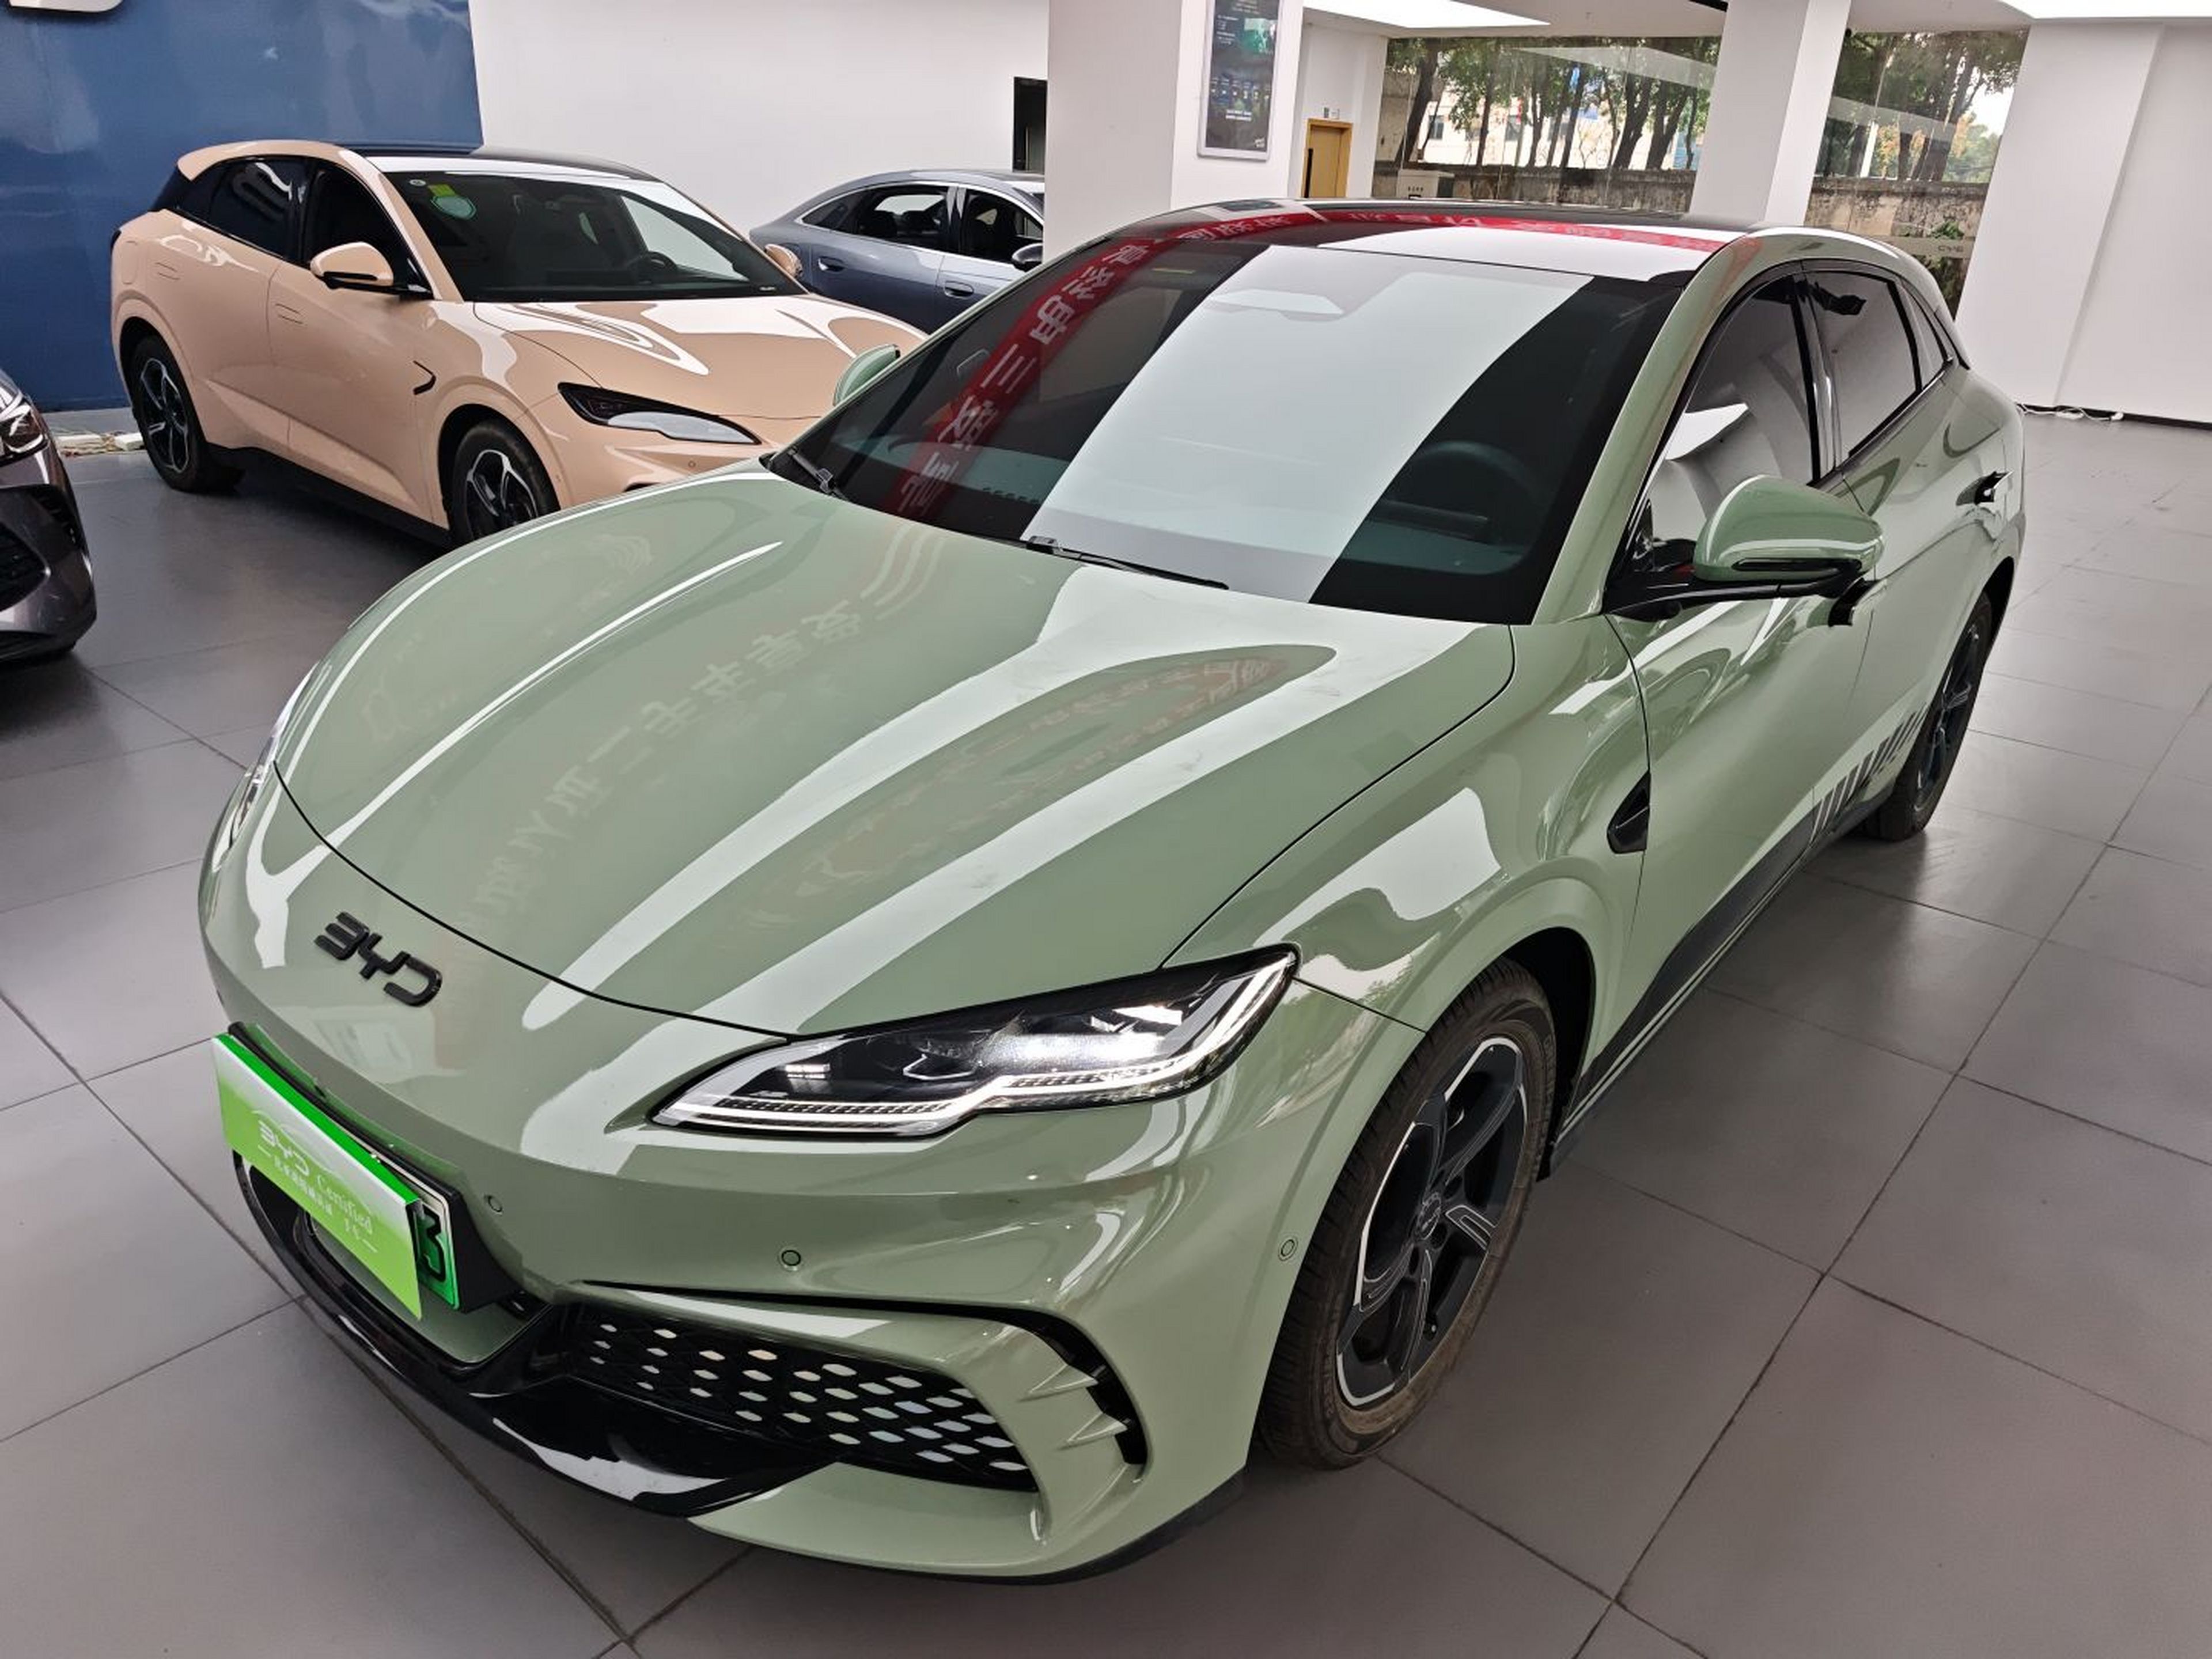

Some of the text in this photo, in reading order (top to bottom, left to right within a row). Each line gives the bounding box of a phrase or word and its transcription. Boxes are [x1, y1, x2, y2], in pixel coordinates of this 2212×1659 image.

[314, 911, 442, 1007] BYD
[257, 1119, 310, 1177] BYD
[317, 1174, 373, 1235] Certified
